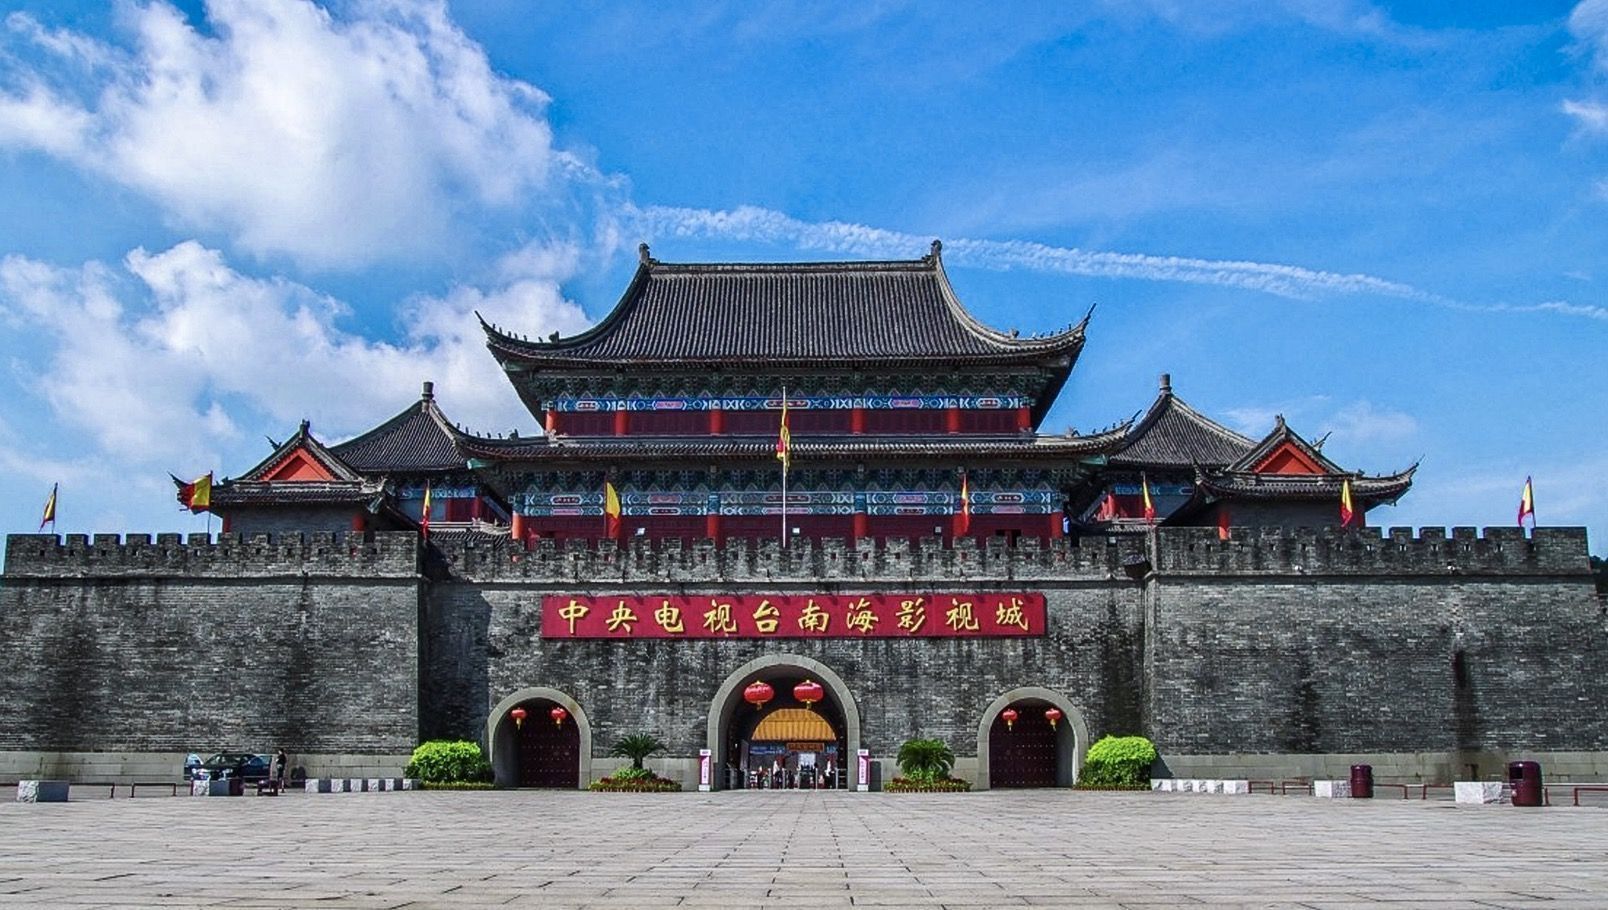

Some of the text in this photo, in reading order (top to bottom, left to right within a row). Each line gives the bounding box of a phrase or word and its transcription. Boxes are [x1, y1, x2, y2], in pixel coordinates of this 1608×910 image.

[558, 598, 1029, 634] 中央电视台南海影视城
